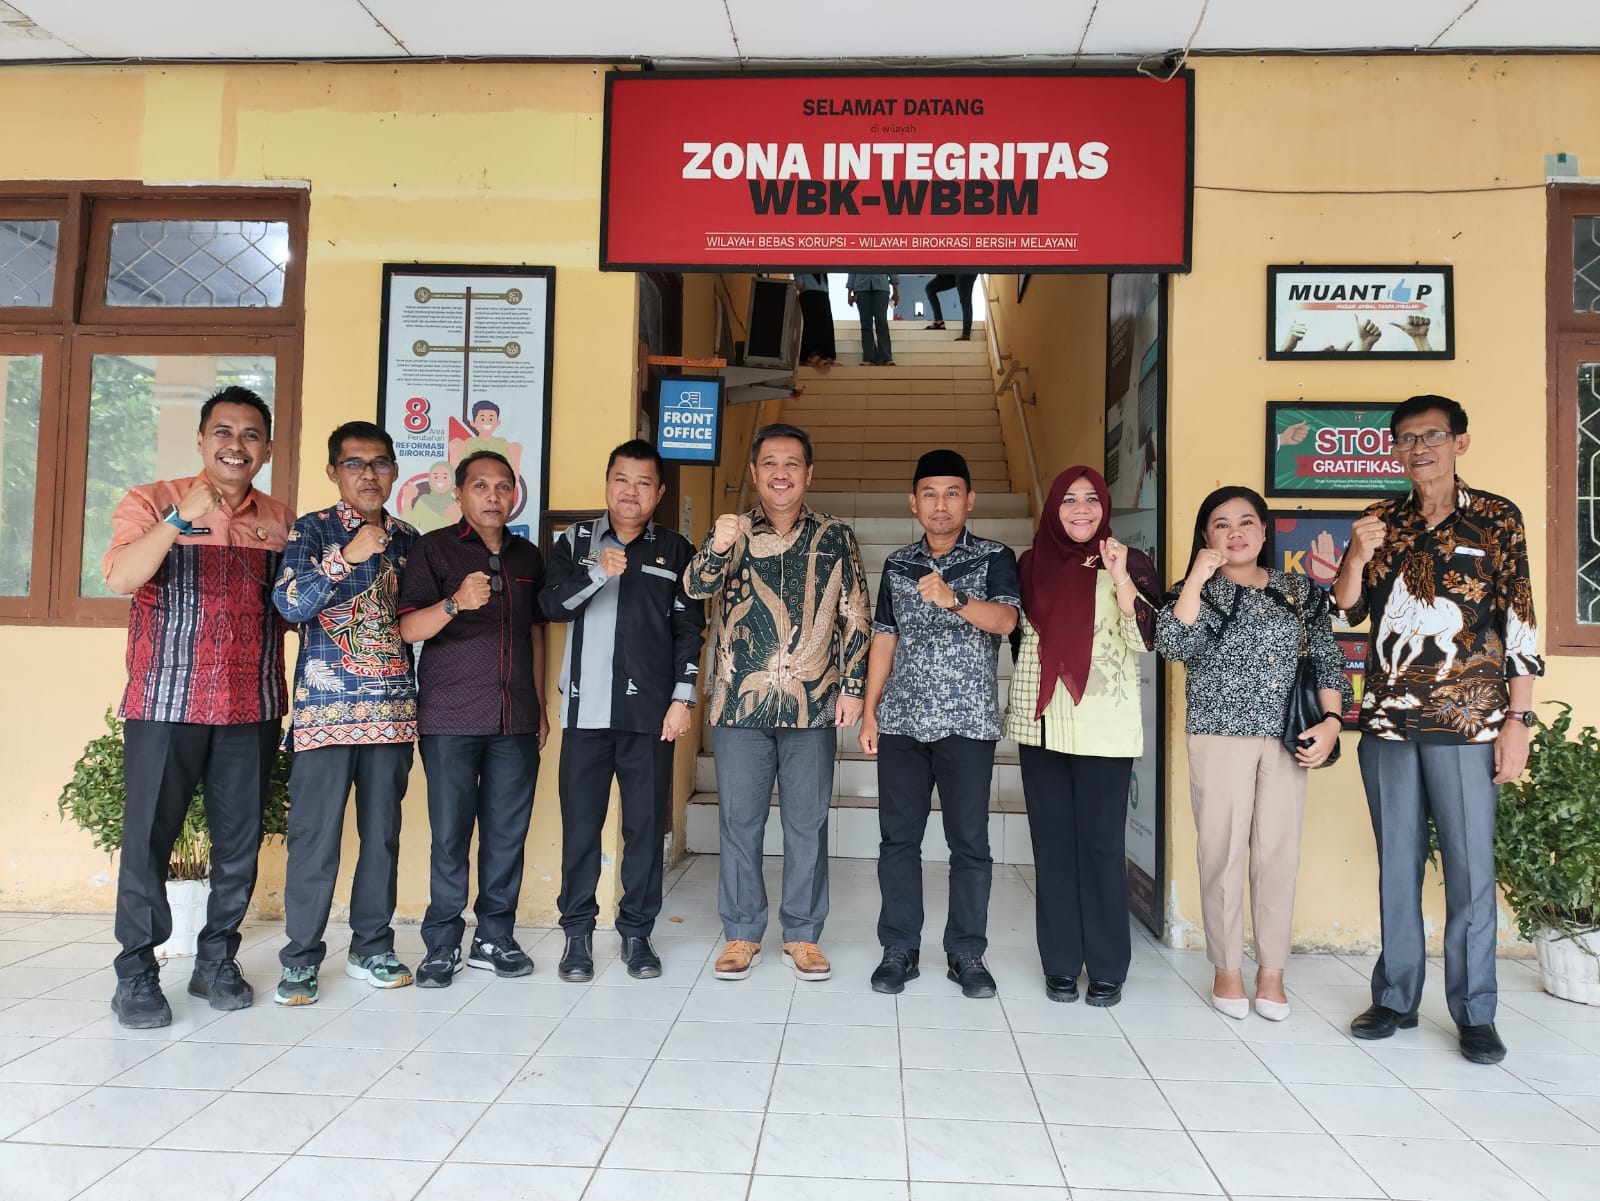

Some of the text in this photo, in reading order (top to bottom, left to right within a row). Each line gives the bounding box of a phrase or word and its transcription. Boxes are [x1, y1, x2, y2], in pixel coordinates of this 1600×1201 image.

[803, 98, 984, 116] SELAMAT DATANG
[870, 124, 916, 134] di wilayah
[682, 142, 1110, 180] ZONA INTEGRITAS
[749, 179, 1038, 216] WBK-WBBM
[706, 236, 755, 248] WILAYAH
[758, 236, 795, 248] BEBAS
[798, 236, 847, 248] KORUPSI
[859, 236, 908, 248] WILAYAH
[911, 237, 972, 248] BIROKRASI
[975, 237, 1017, 248] BERSIH
[1020, 237, 1077, 248] MELAYANI
[403, 396, 431, 434] 8
[663, 411, 714, 425] FRONT
[662, 426, 713, 440] OFFICE
[395, 442, 445, 450] REFORMASI
[399, 449, 445, 457] BIROKRASI
